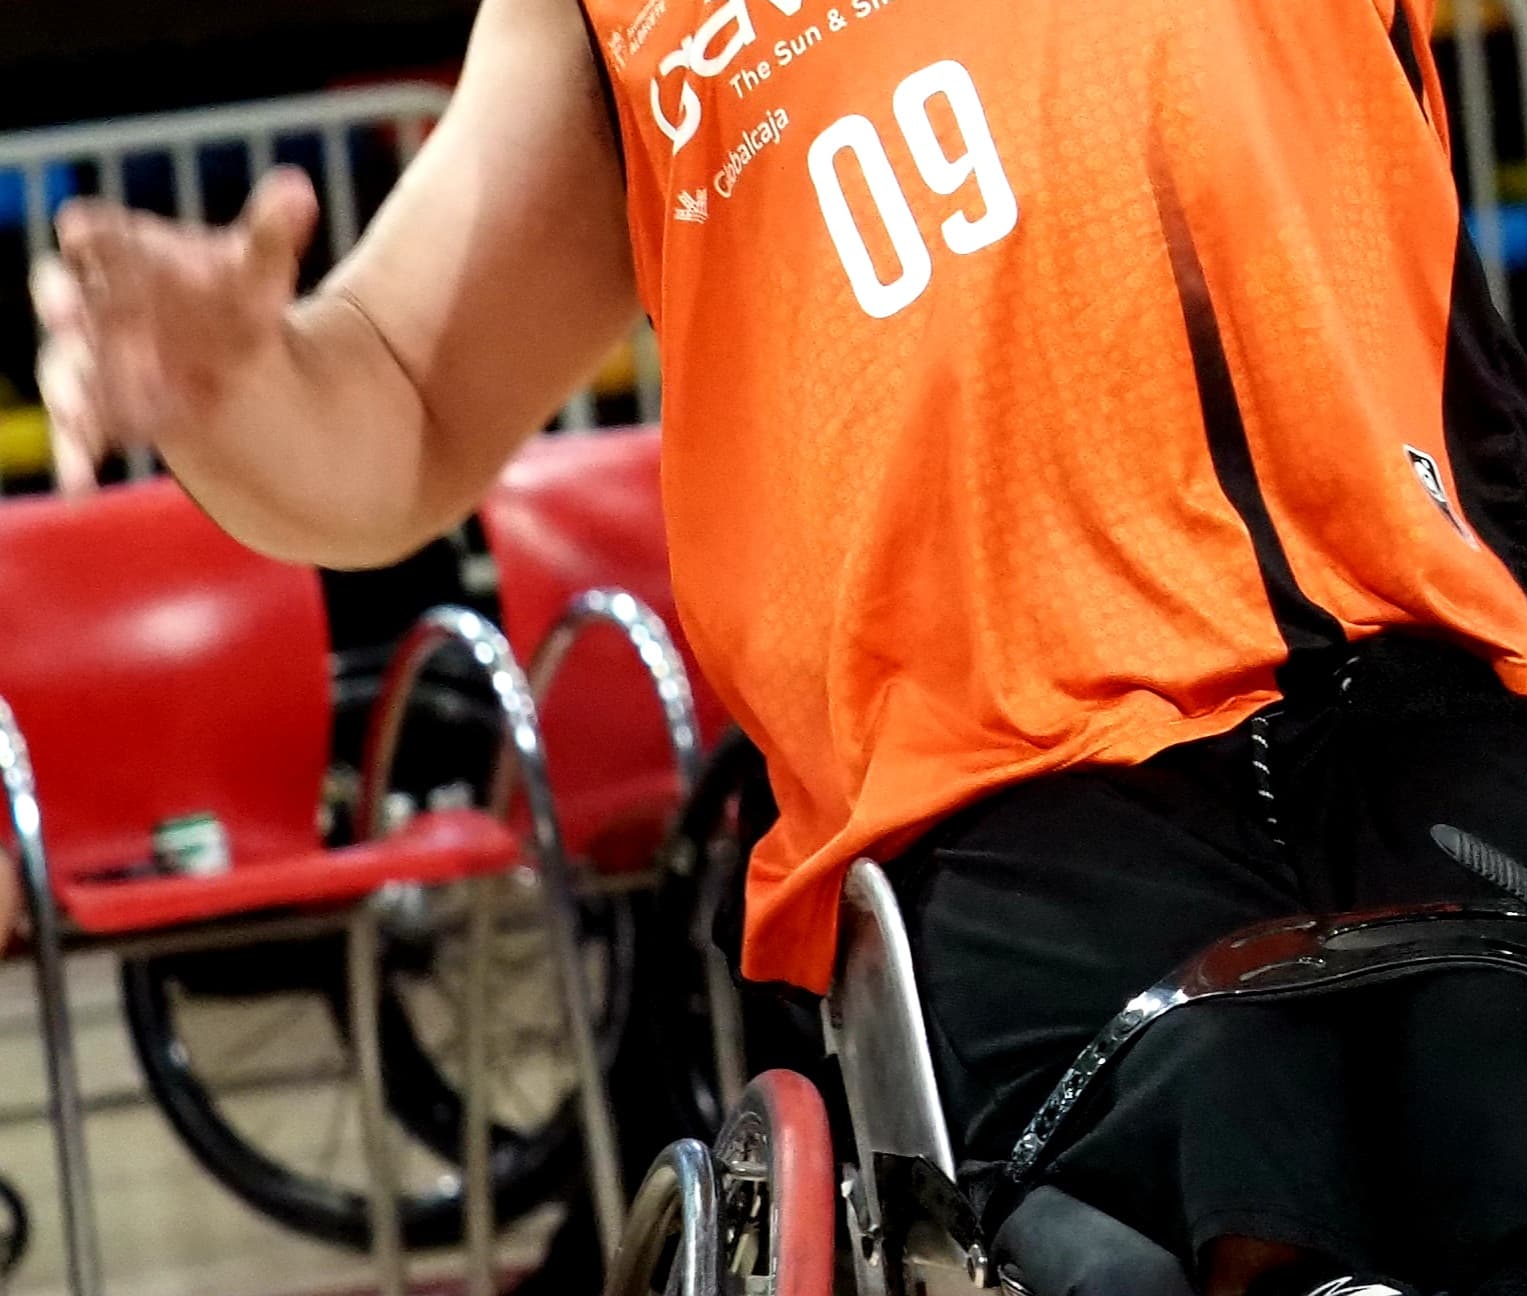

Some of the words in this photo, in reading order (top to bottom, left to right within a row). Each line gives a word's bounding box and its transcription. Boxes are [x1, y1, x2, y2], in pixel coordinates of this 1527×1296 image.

[729, 68, 772, 100] The
[773, 25, 823, 67] Sun
[826, 8, 848, 32] &
[714, 106, 790, 199] Globalcaja
[807, 58, 1019, 319] 09
